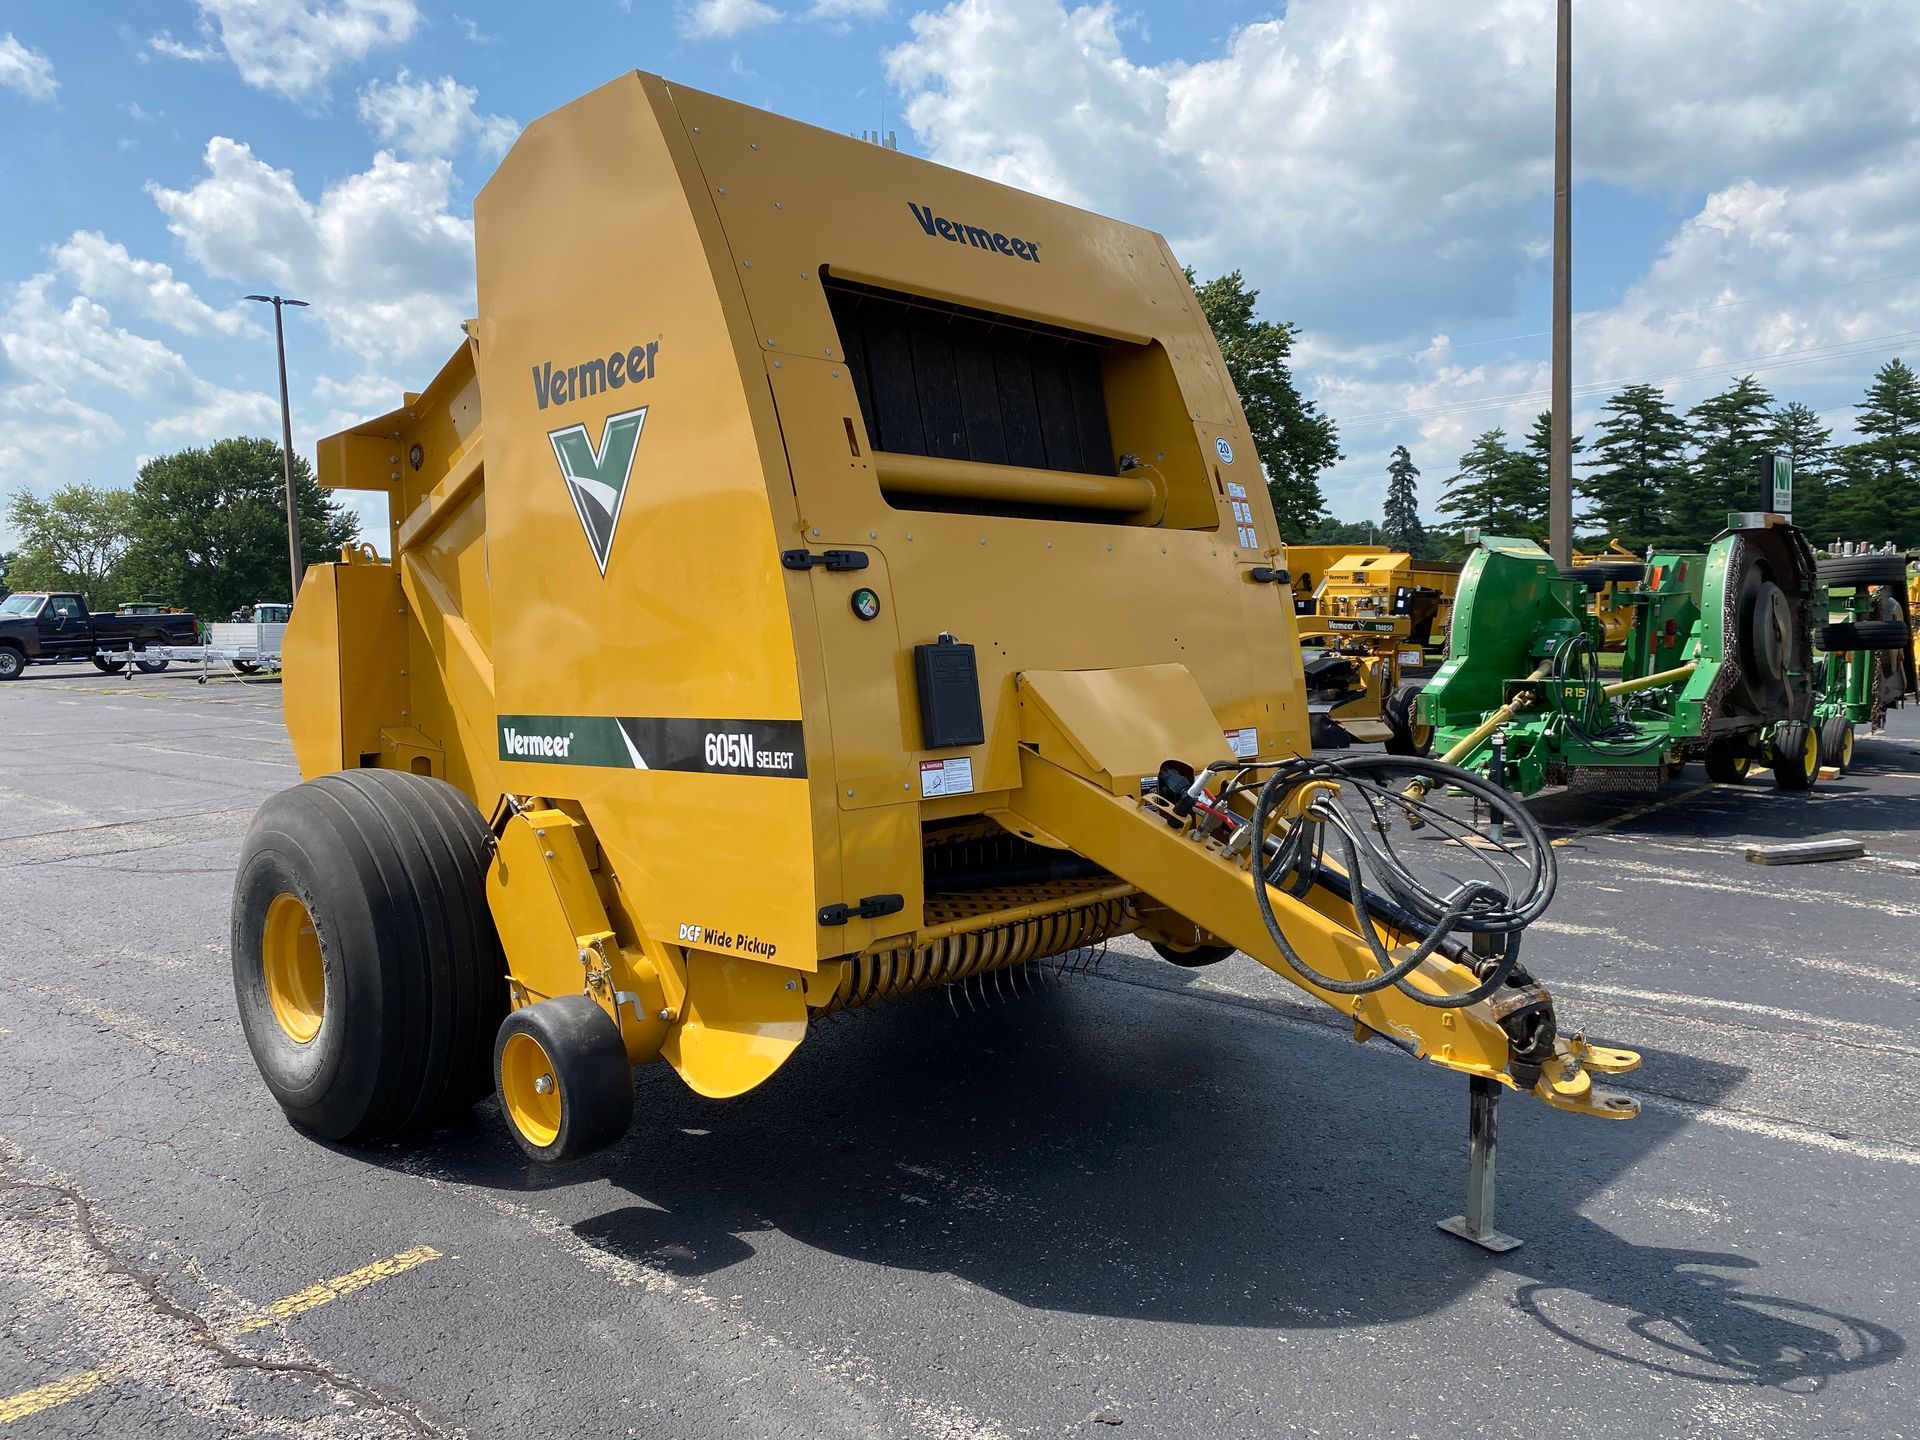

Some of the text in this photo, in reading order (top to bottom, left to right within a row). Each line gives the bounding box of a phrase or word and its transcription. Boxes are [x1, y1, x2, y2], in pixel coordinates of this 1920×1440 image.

[907, 202, 1041, 264] Vermeer
[532, 340, 659, 411] Vermeer
[1218, 442, 1229, 454] 20
[1328, 620, 1354, 630] Vermeer
[503, 728, 794, 770] Vermeer 605N SELECT
[679, 923, 776, 959] DCF Wide Pickup
